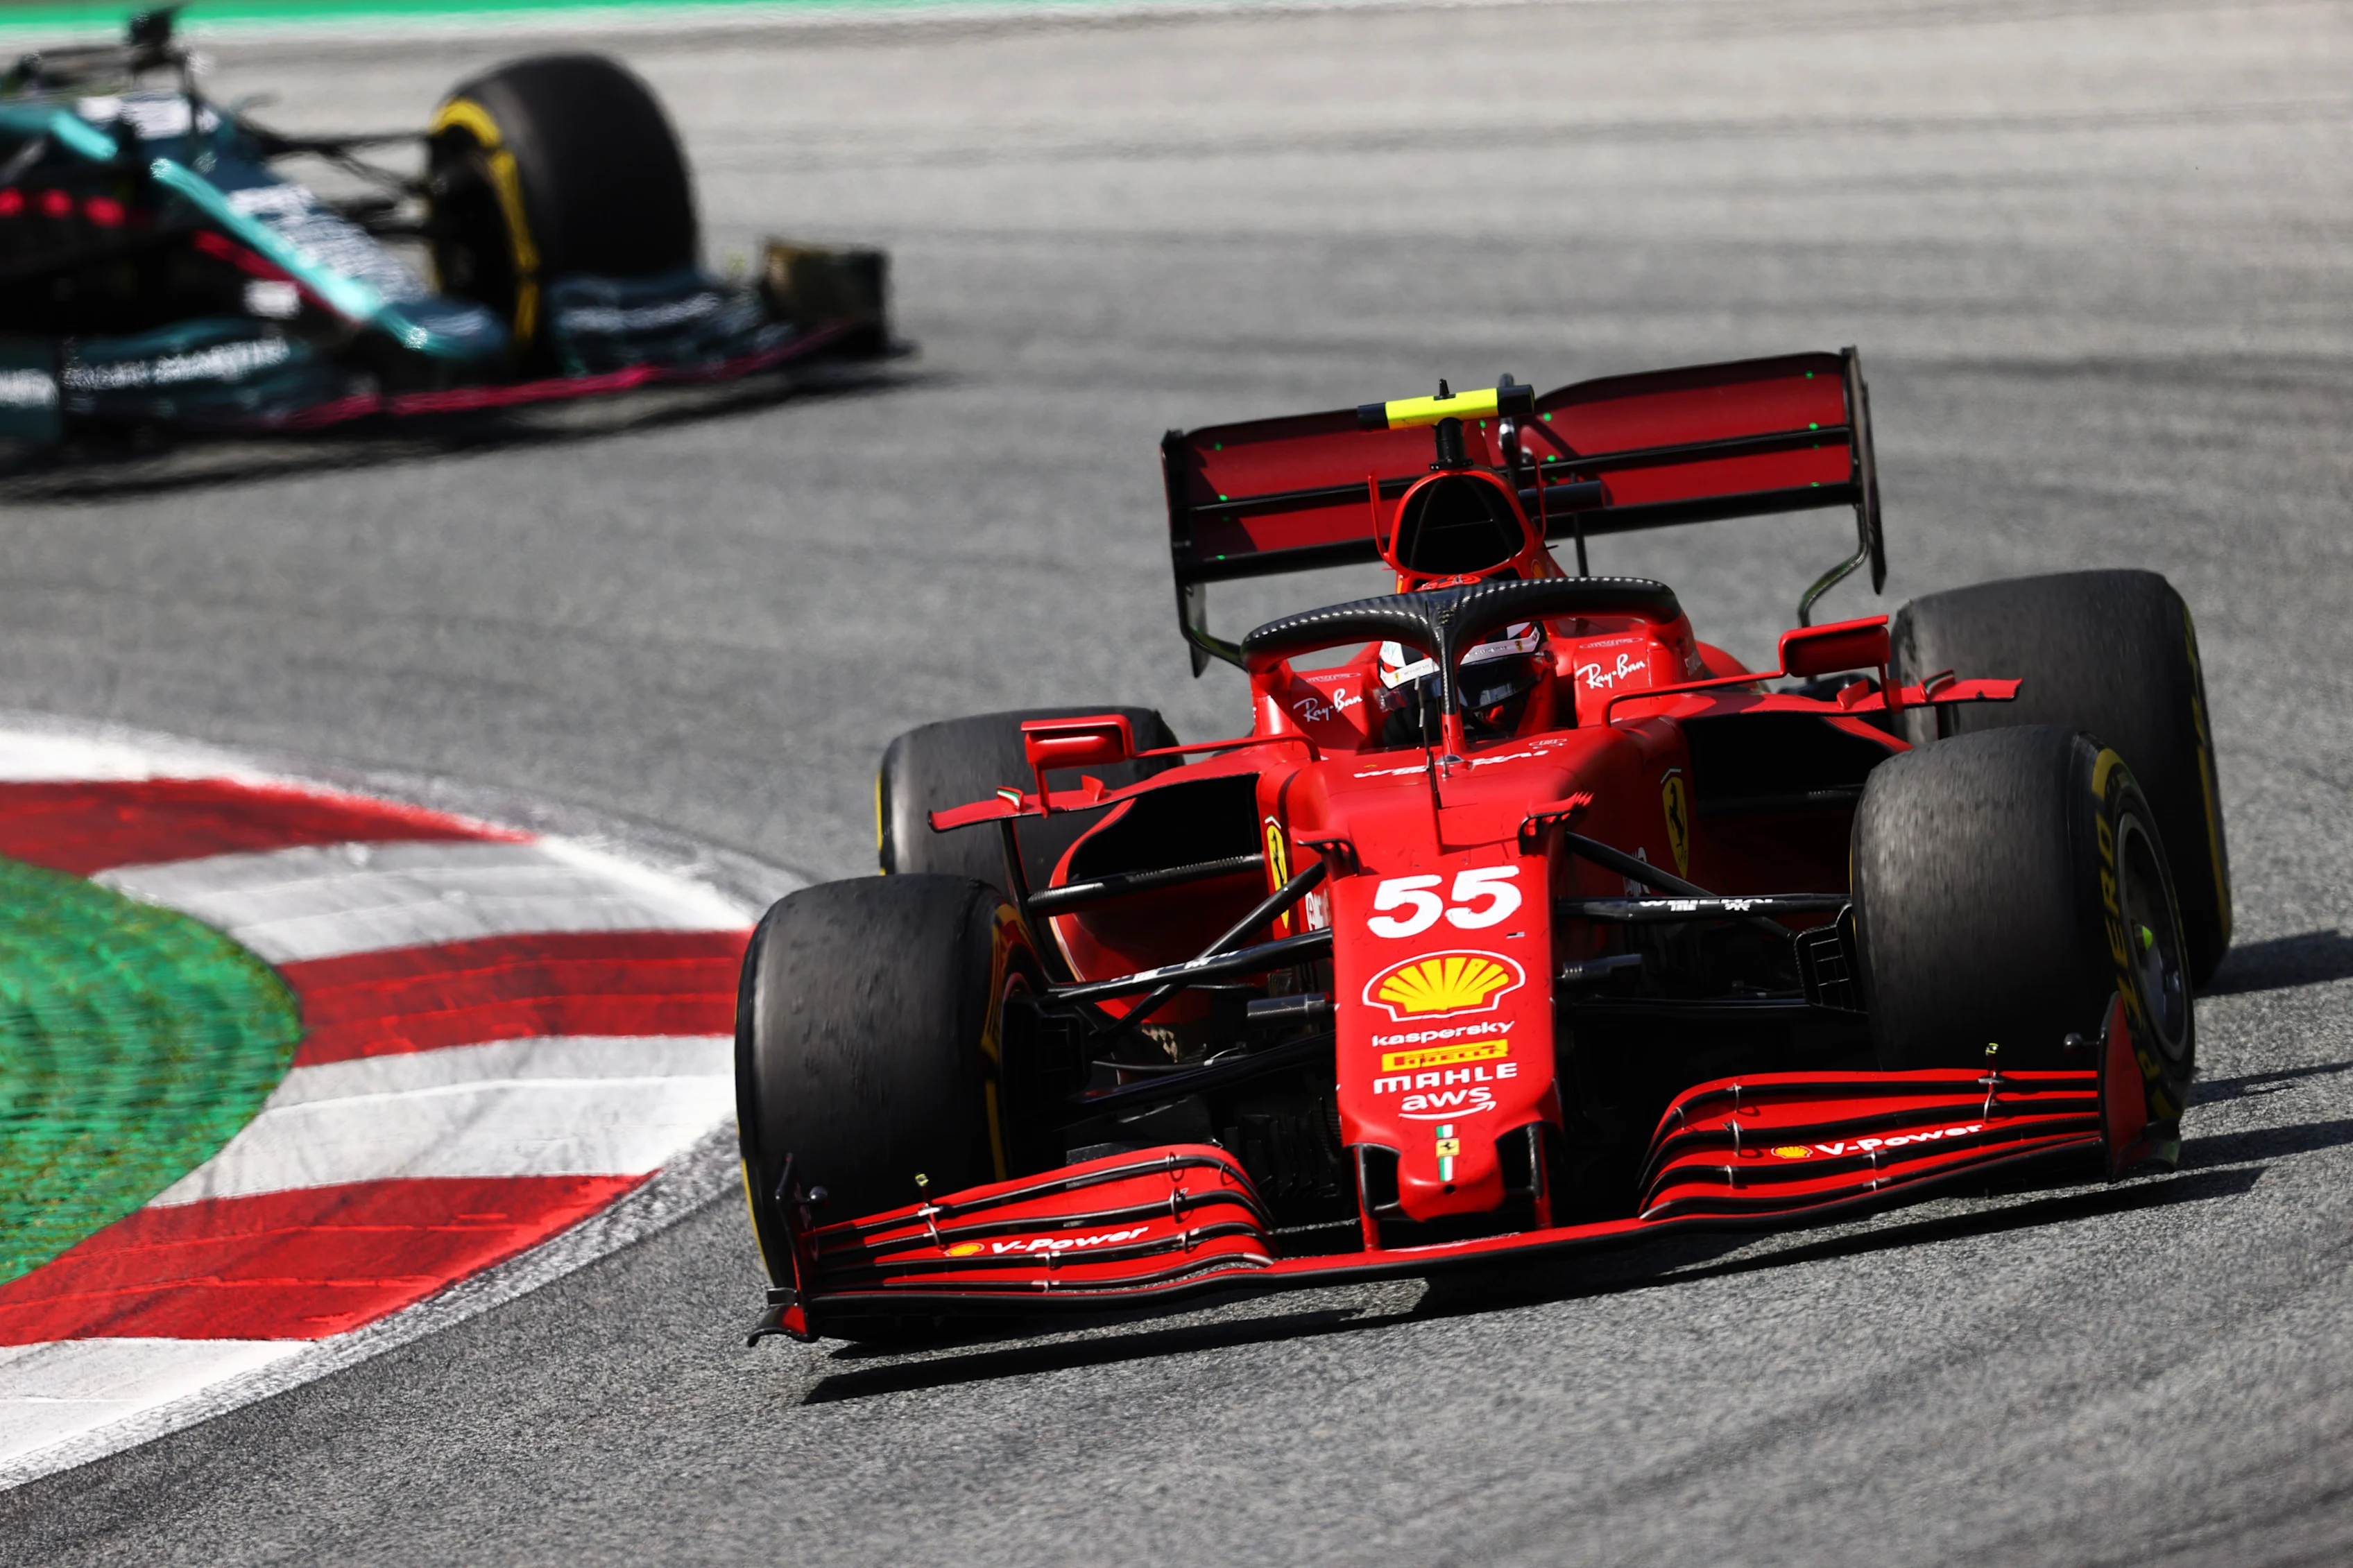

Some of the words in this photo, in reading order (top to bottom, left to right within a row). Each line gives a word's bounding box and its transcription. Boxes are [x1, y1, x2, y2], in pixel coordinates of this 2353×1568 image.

[1575, 653, 1646, 689] Ray-Ban
[1292, 687, 1363, 723] Ray-Ban
[1367, 865, 1523, 938] 55
[1371, 1020, 1515, 1047] kaspersky
[1373, 1062, 1518, 1095] MAHLE
[1401, 1086, 1492, 1112] aws
[1815, 1123, 1983, 1156] V-Power
[991, 1226, 1149, 1254] V-Power
